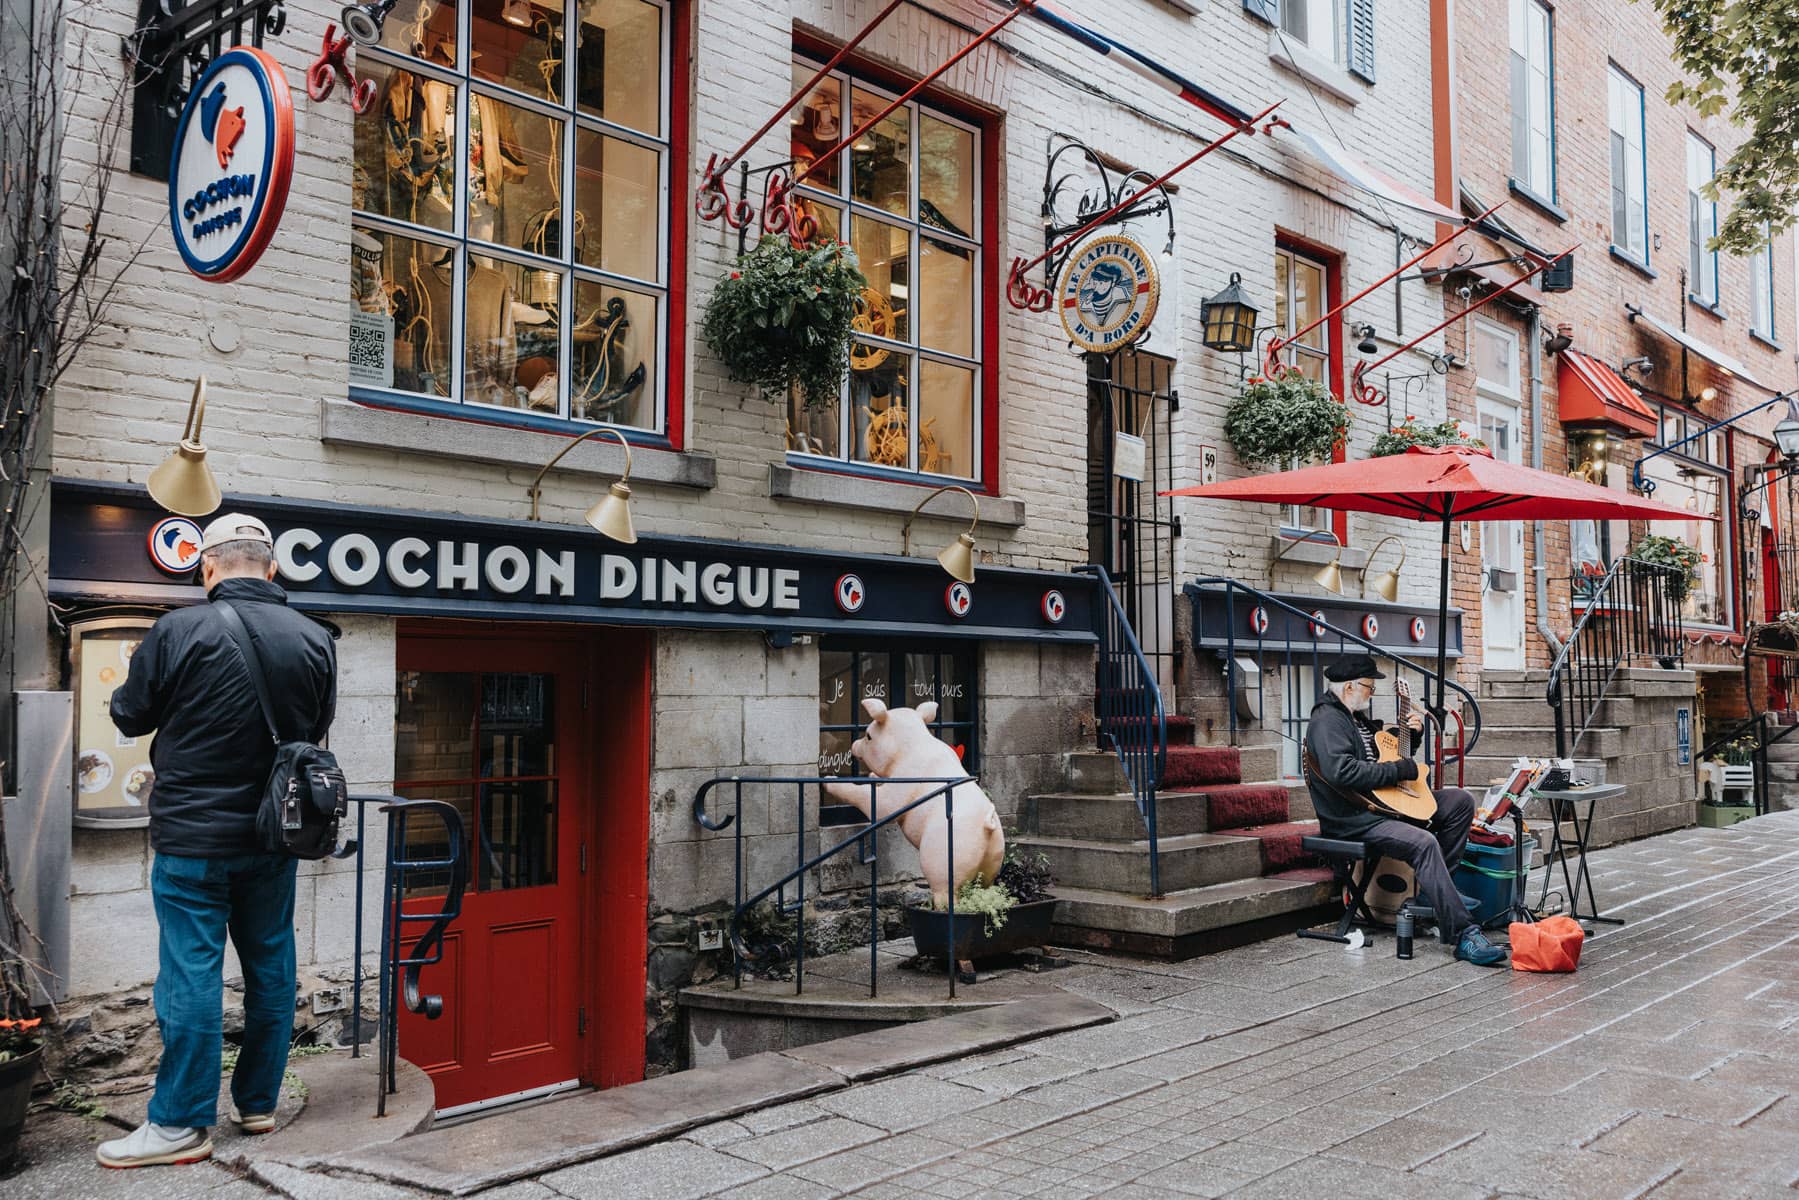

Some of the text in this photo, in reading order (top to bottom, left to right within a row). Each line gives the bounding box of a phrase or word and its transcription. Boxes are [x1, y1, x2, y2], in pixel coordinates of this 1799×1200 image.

[184, 174, 256, 220] COCHON
[1068, 243, 1147, 293] LE CAPITAINE
[1104, 311, 1140, 343] BORD
[1205, 453, 1215, 468] 59
[274, 528, 800, 609] COCHON DINGUE
[865, 677, 886, 698] suis
[818, 750, 852, 773] dingue
